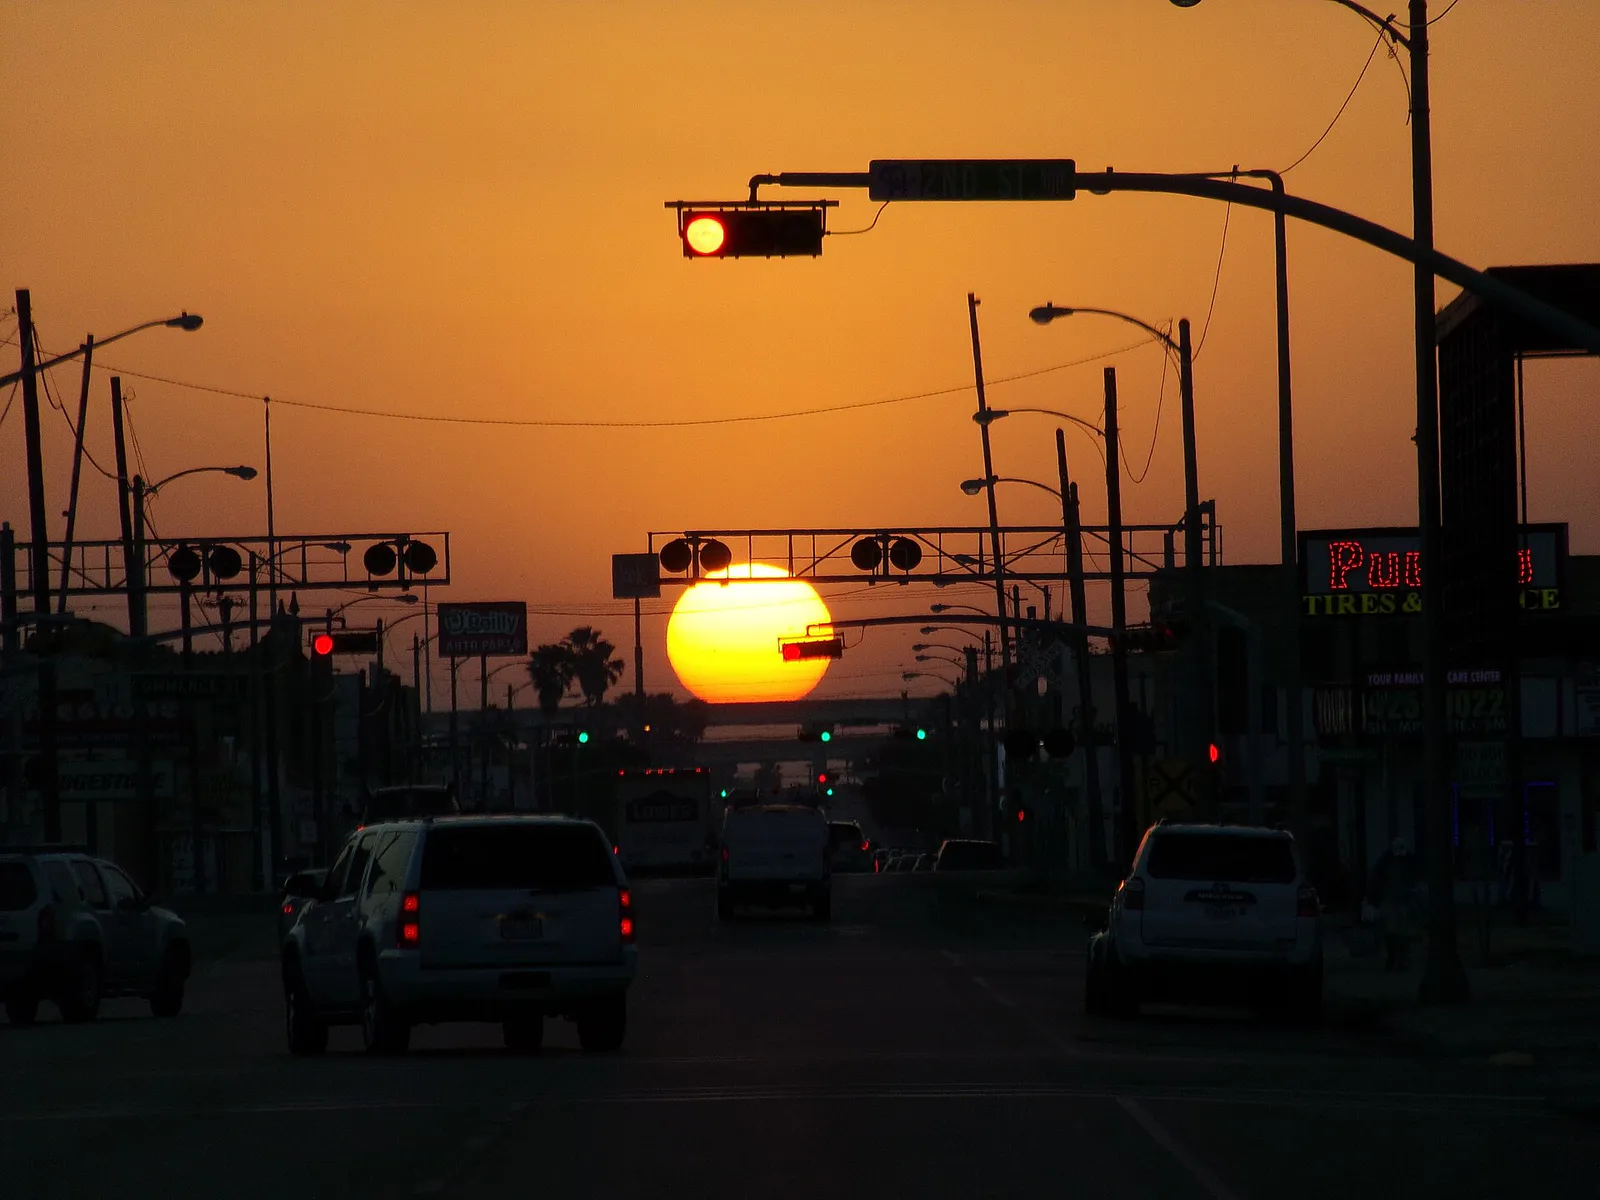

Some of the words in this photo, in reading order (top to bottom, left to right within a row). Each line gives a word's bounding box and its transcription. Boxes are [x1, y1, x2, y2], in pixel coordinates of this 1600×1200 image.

[1303, 593, 1395, 615] TIRES
[1402, 591, 1423, 613] &
[1368, 674, 1392, 686] YOUR
[1394, 673, 1425, 685] FAMILY
